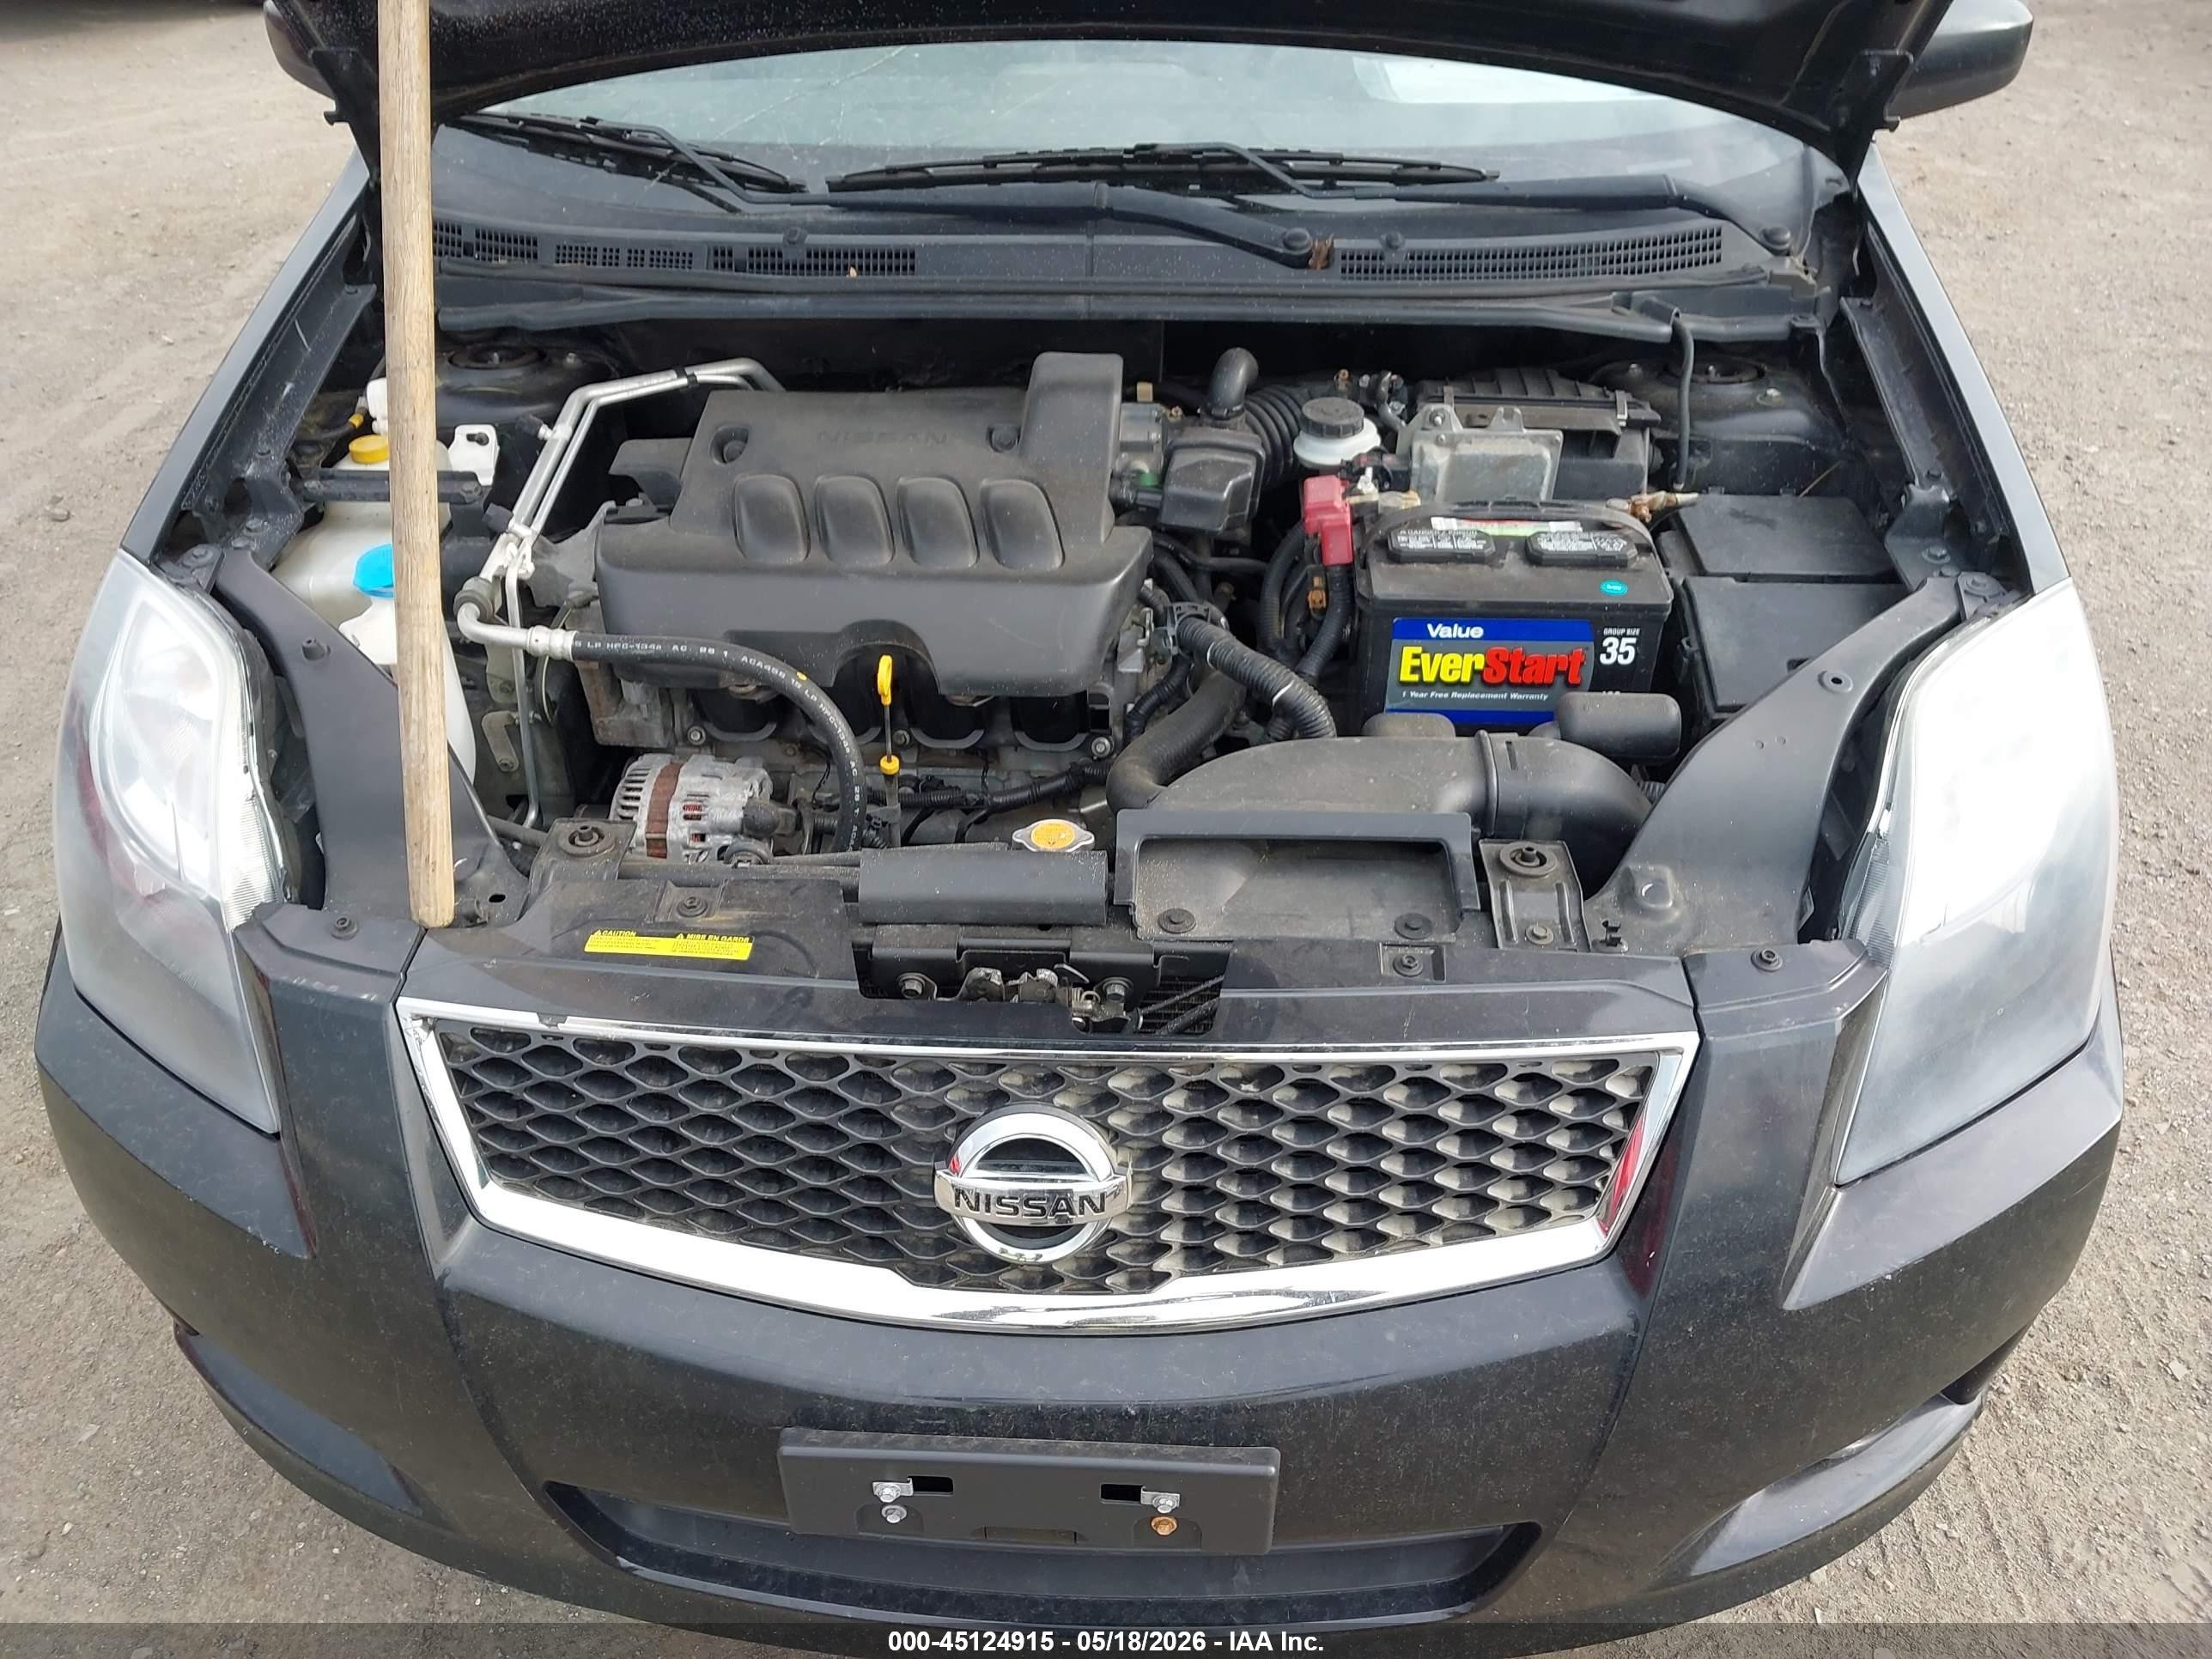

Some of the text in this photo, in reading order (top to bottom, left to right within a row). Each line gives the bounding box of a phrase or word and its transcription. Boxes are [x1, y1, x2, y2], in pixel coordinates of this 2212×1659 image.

[1426, 623, 1485, 640] Value
[1603, 627, 1626, 635] GROUP
[1599, 636, 1638, 665] 35
[1399, 646, 1586, 686] EverStart
[1409, 690, 1429, 699] Year
[1430, 690, 1449, 699] Free
[1450, 691, 1508, 701] Replacement
[1510, 692, 1549, 702] Warranty
[602, 929, 637, 938] CAUTION
[721, 935, 750, 944] GARDE
[954, 1188, 1108, 1219] NISSAN
